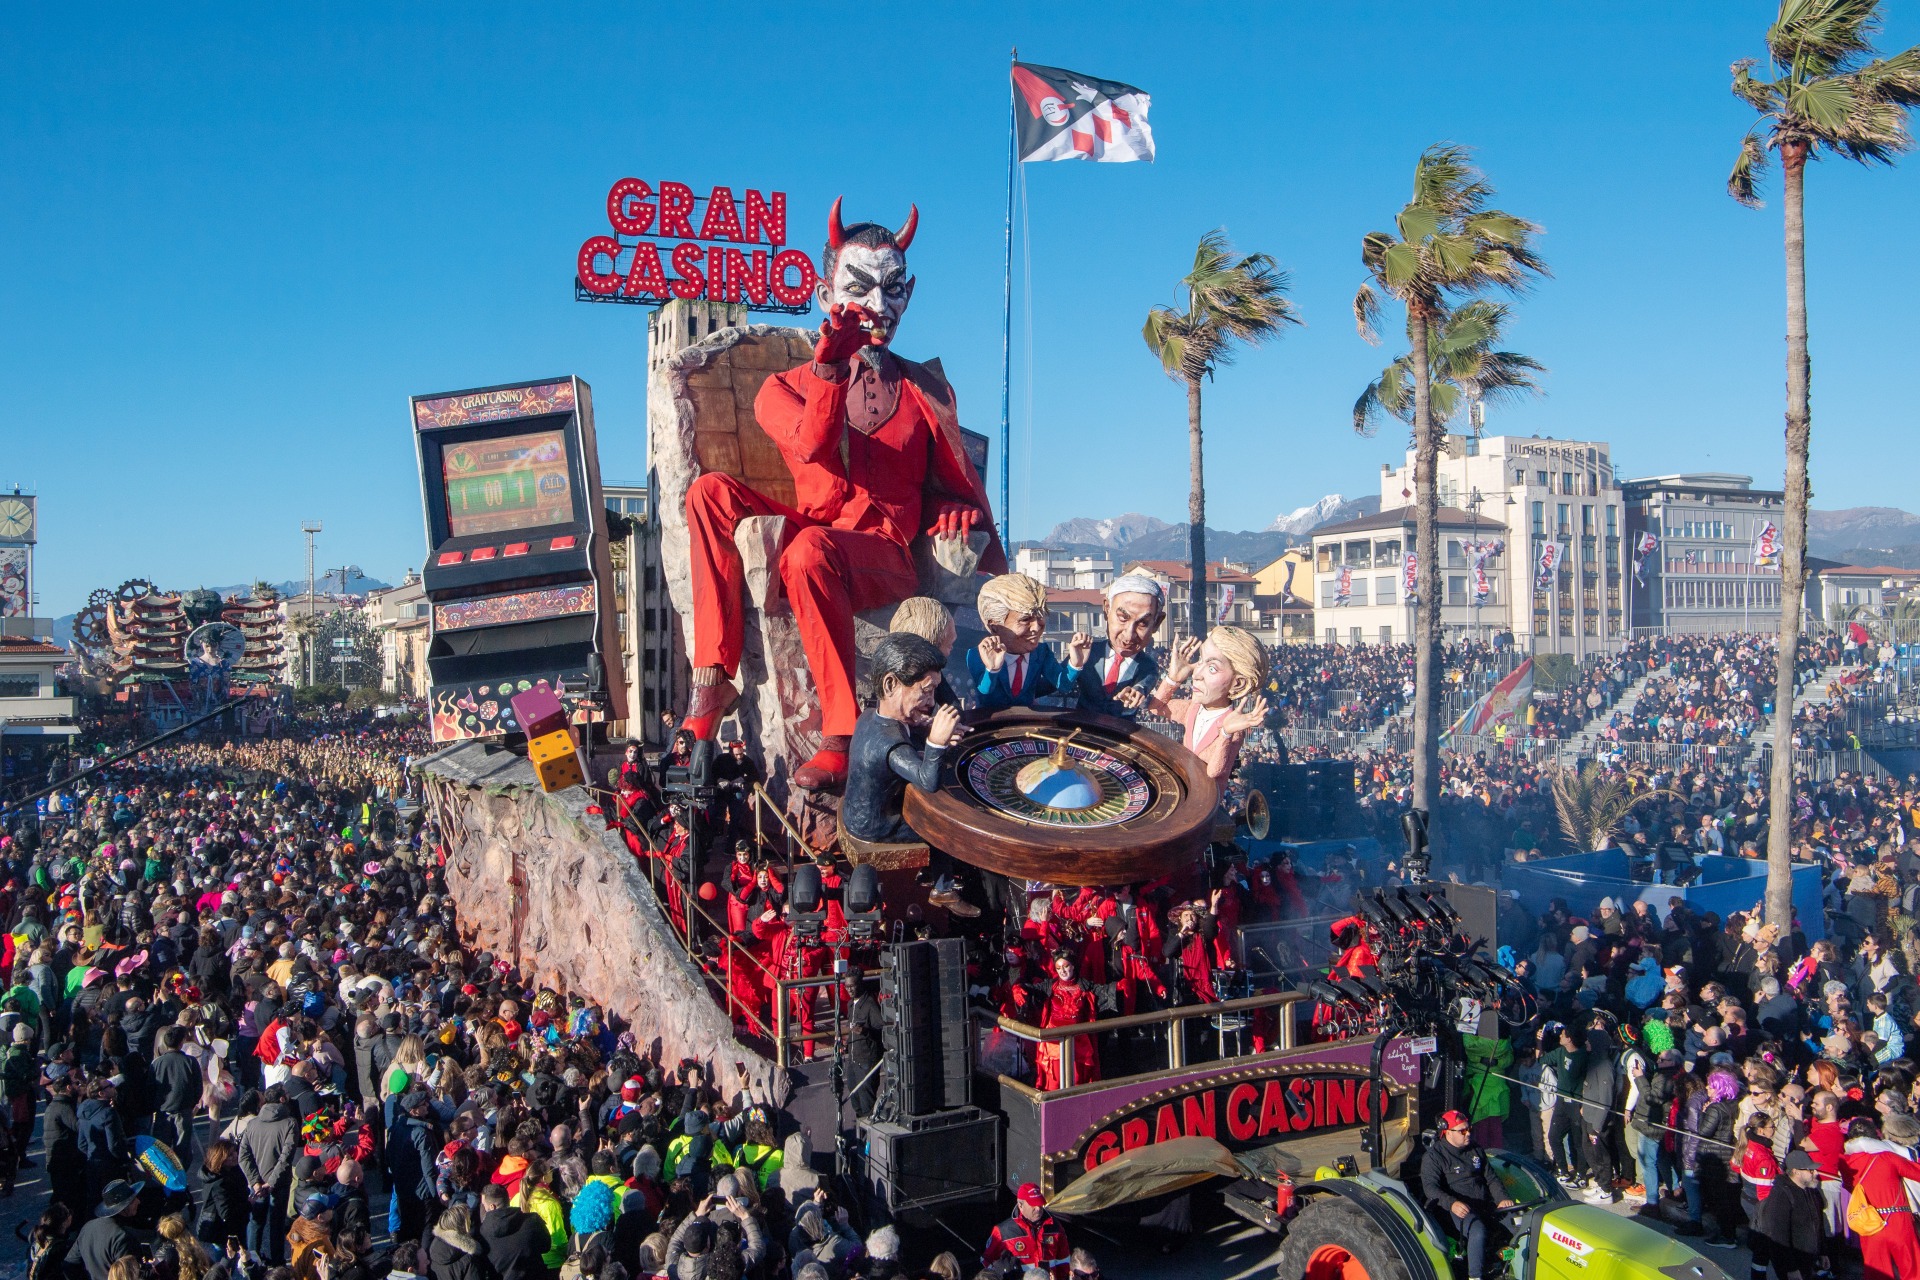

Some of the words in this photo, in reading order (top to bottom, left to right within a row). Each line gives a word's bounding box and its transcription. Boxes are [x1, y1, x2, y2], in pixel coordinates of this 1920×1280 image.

[607, 177, 787, 246] GRAN
[577, 235, 816, 306] CASINO
[462, 393, 488, 409] GRAN
[489, 390, 523, 404] CASINO
[991, 749, 1003, 758] 28
[1002, 746, 1010, 755] 9
[1011, 744, 1022, 753] 26
[1023, 743, 1034, 751] 30
[1038, 742, 1045, 751] 11
[1109, 761, 1122, 771] 22
[1083, 1089, 1216, 1174] GRAN
[1226, 1077, 1389, 1142] CASINO
[1552, 1231, 1583, 1251] CLAAS
